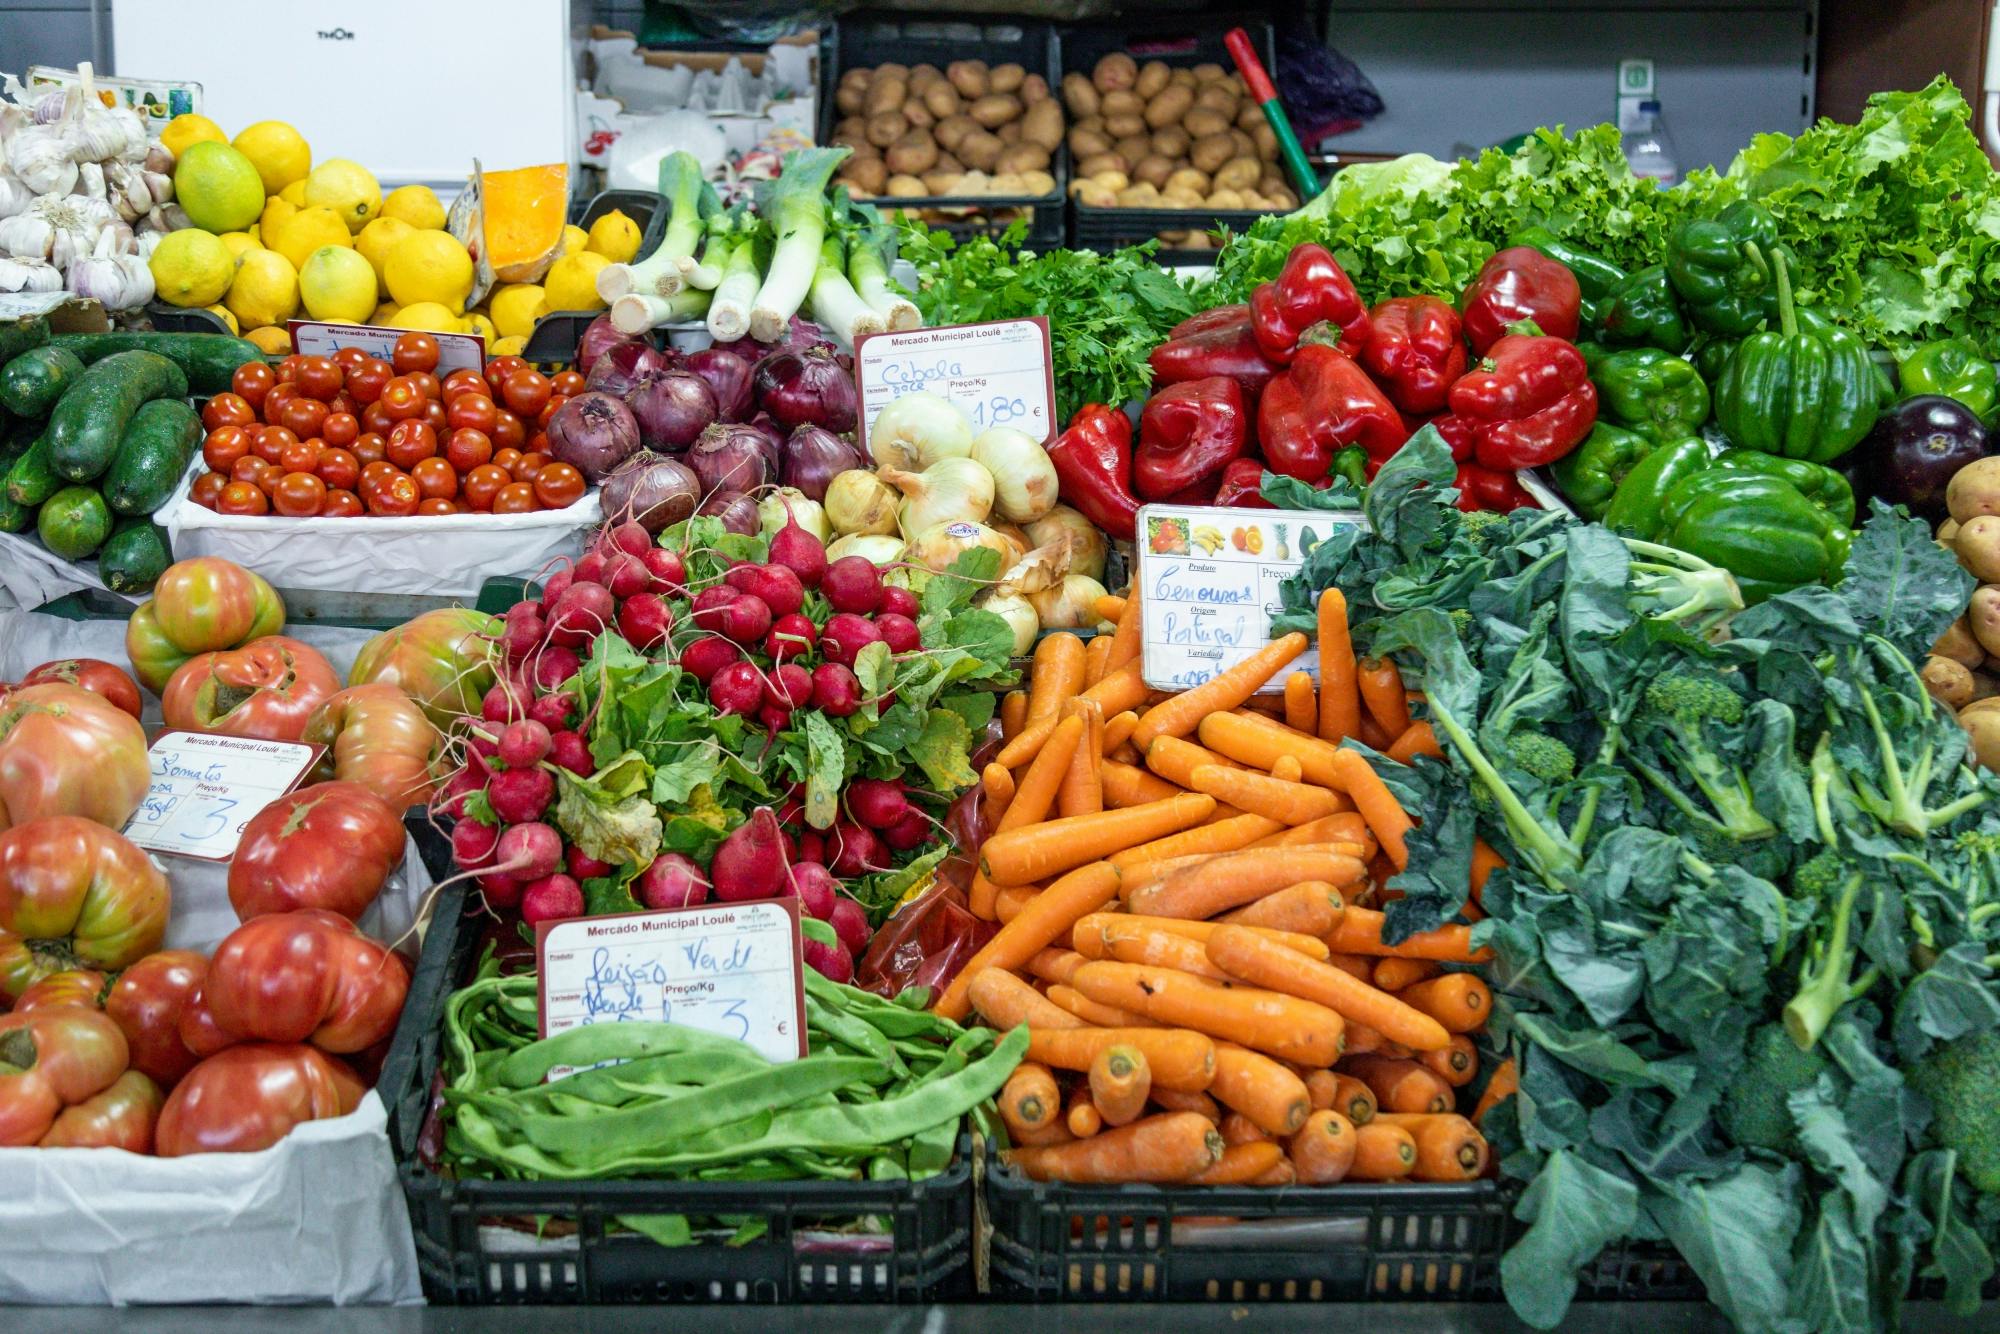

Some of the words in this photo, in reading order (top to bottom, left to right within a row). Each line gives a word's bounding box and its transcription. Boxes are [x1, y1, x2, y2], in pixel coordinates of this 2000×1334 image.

[327, 328, 366, 337] Mercado
[368, 331, 400, 339] Munici
[892, 336, 929, 347] Mercado
[931, 331, 974, 343] Municipal
[976, 328, 1001, 338] Loulé
[882, 360, 962, 385] Cebola
[950, 378, 987, 388] Preço/Kg
[1188, 562, 1217, 573] Produto
[1262, 567, 1291, 579] Preço
[1190, 605, 1217, 616] Origem
[1161, 611, 1246, 655] Portugal
[1187, 648, 1224, 659] Variedade
[184, 736, 218, 746] Mercado
[219, 740, 257, 751] Municipal
[256, 744, 280, 753] Loulé
[180, 798, 239, 840] 3
[587, 923, 639, 937] Mercado
[642, 916, 699, 931] Municipal
[702, 912, 736, 925] Loulé
[665, 981, 715, 994] Preço/Kg
[707, 999, 749, 1041] 3
[777, 1020, 788, 1036] €
